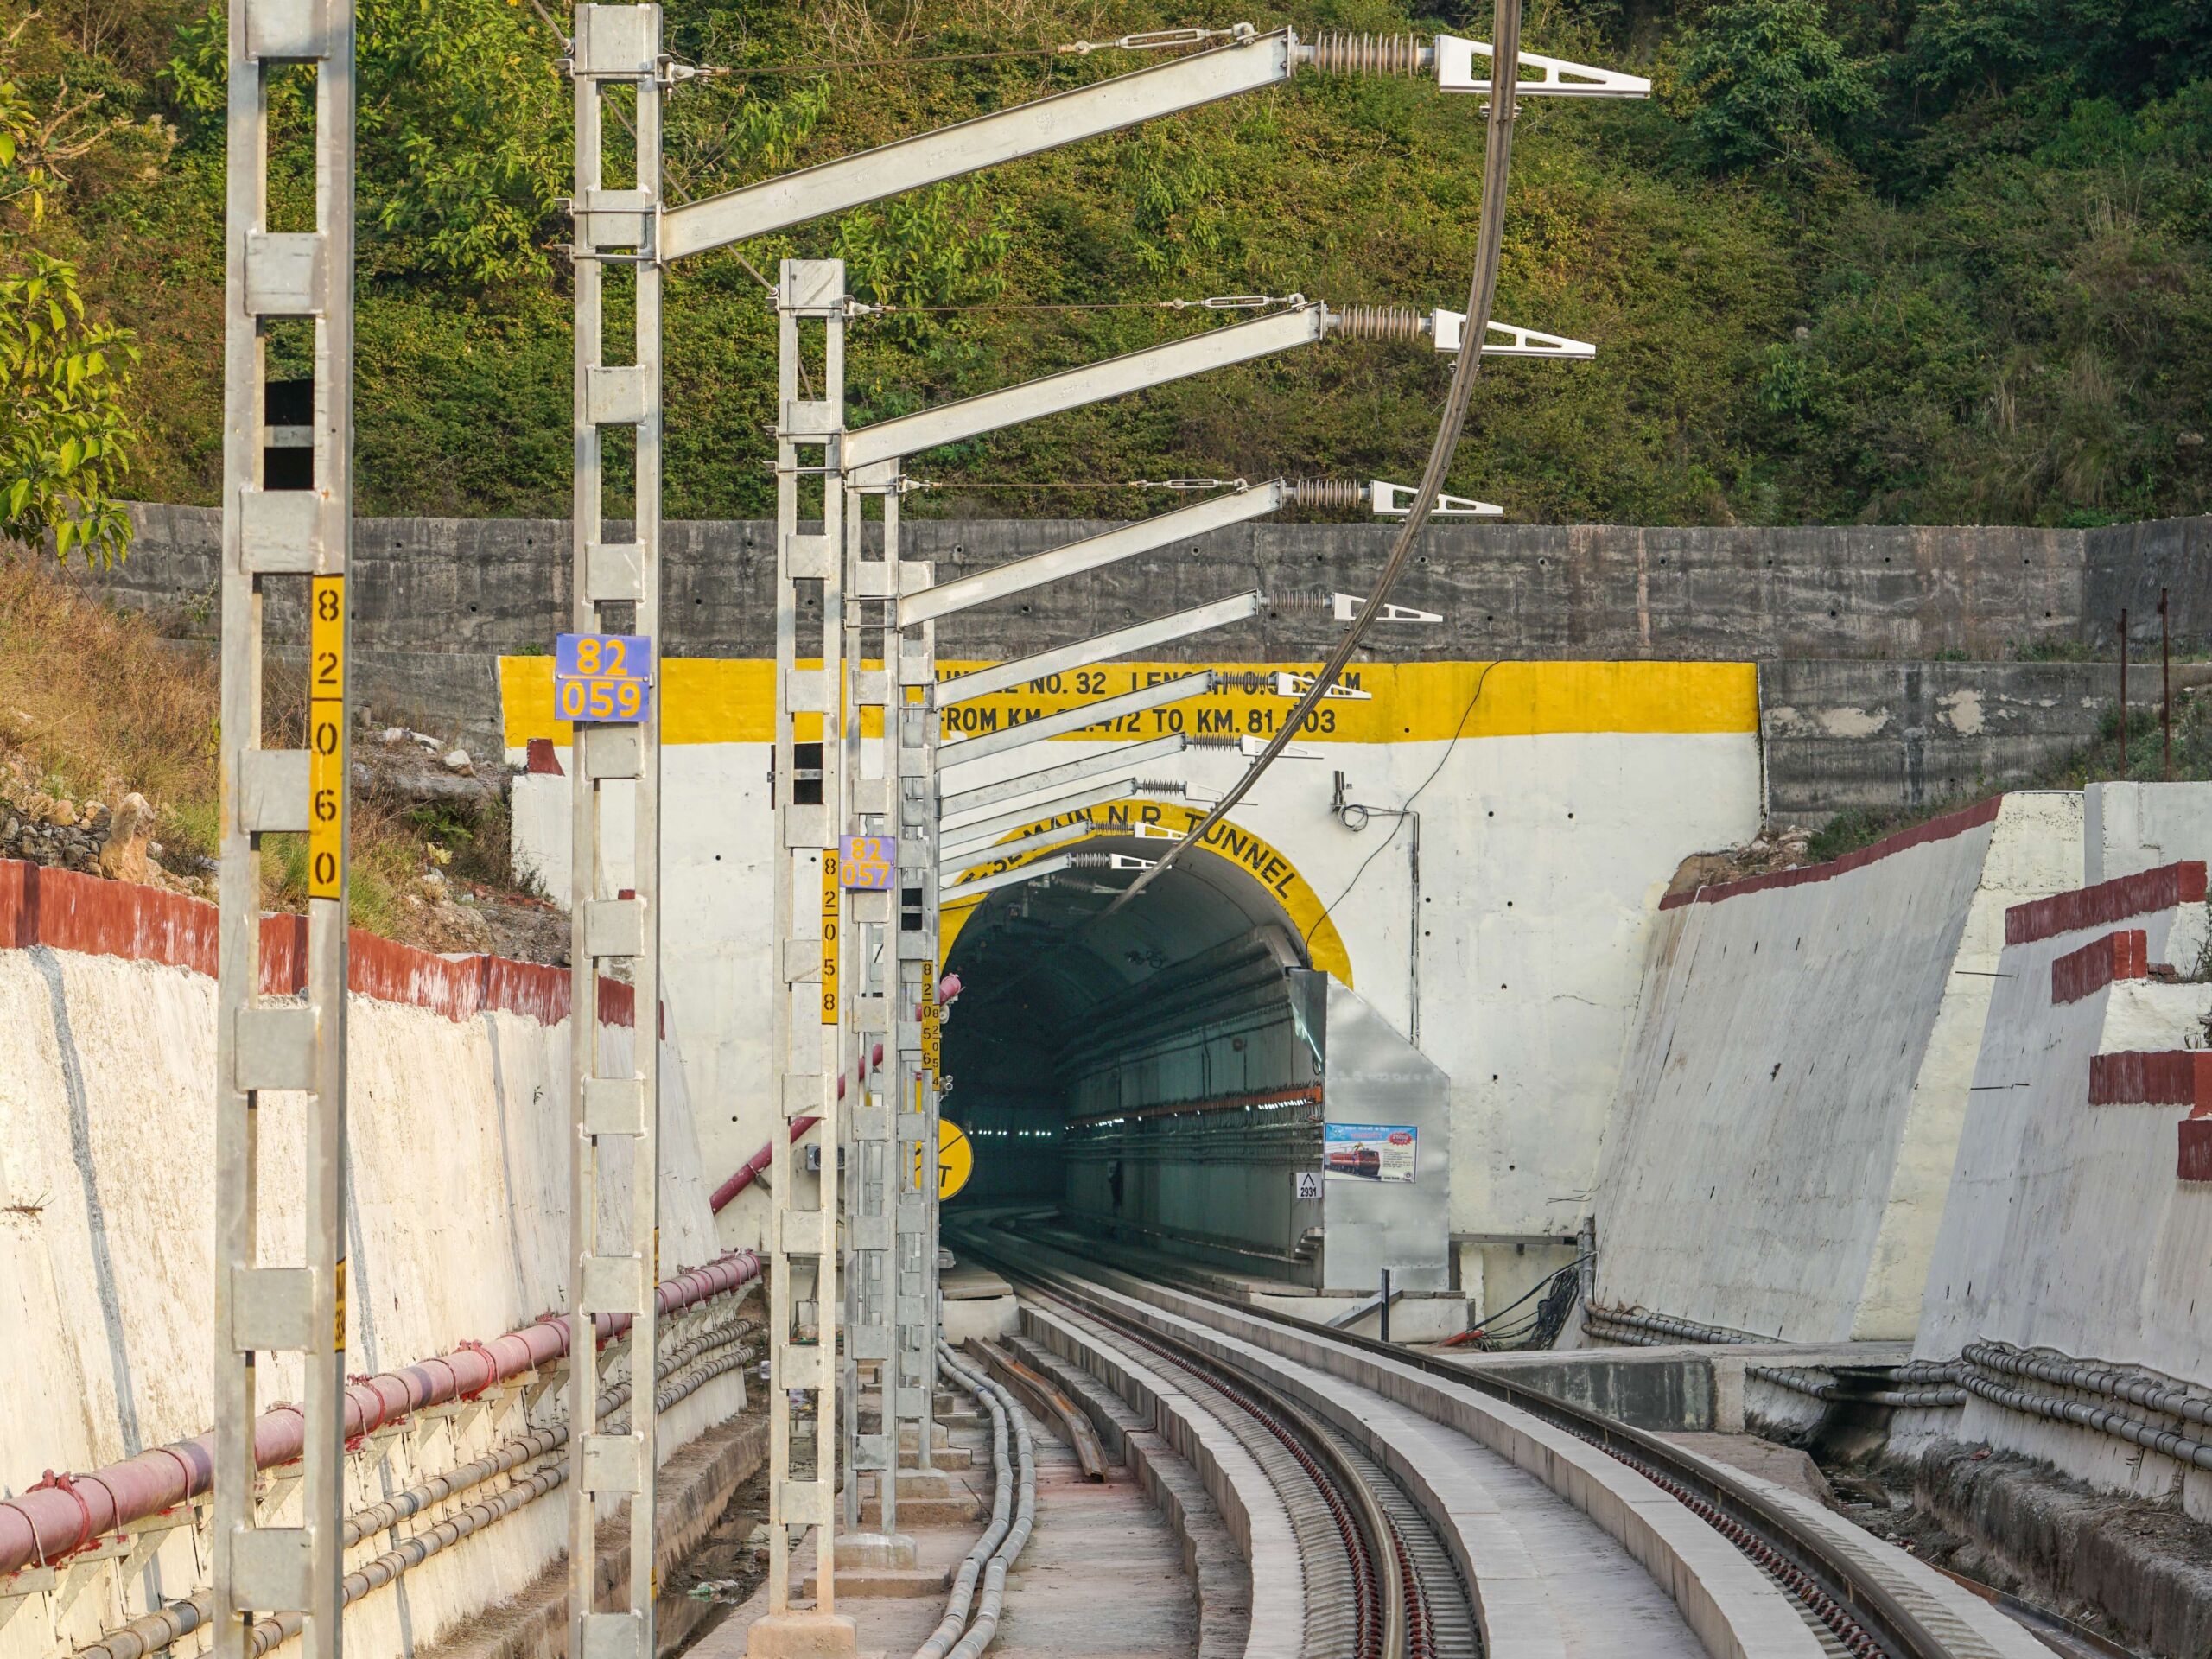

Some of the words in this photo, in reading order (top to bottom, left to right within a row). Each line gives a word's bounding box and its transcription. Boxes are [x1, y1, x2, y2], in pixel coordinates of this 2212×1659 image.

[576, 638, 628, 676] 82
[1029, 672, 1069, 695] NO.
[1075, 671, 1107, 695] 32
[562, 680, 642, 718] 059
[1152, 709, 1184, 733] TO
[1197, 709, 1241, 733] KM.
[1247, 709, 1336, 734] 81.03
[850, 837, 882, 861] 82
[1185, 811, 1296, 899] TUNNEL
[842, 863, 891, 887] 057
[1300, 1186, 1317, 1198] 2931
